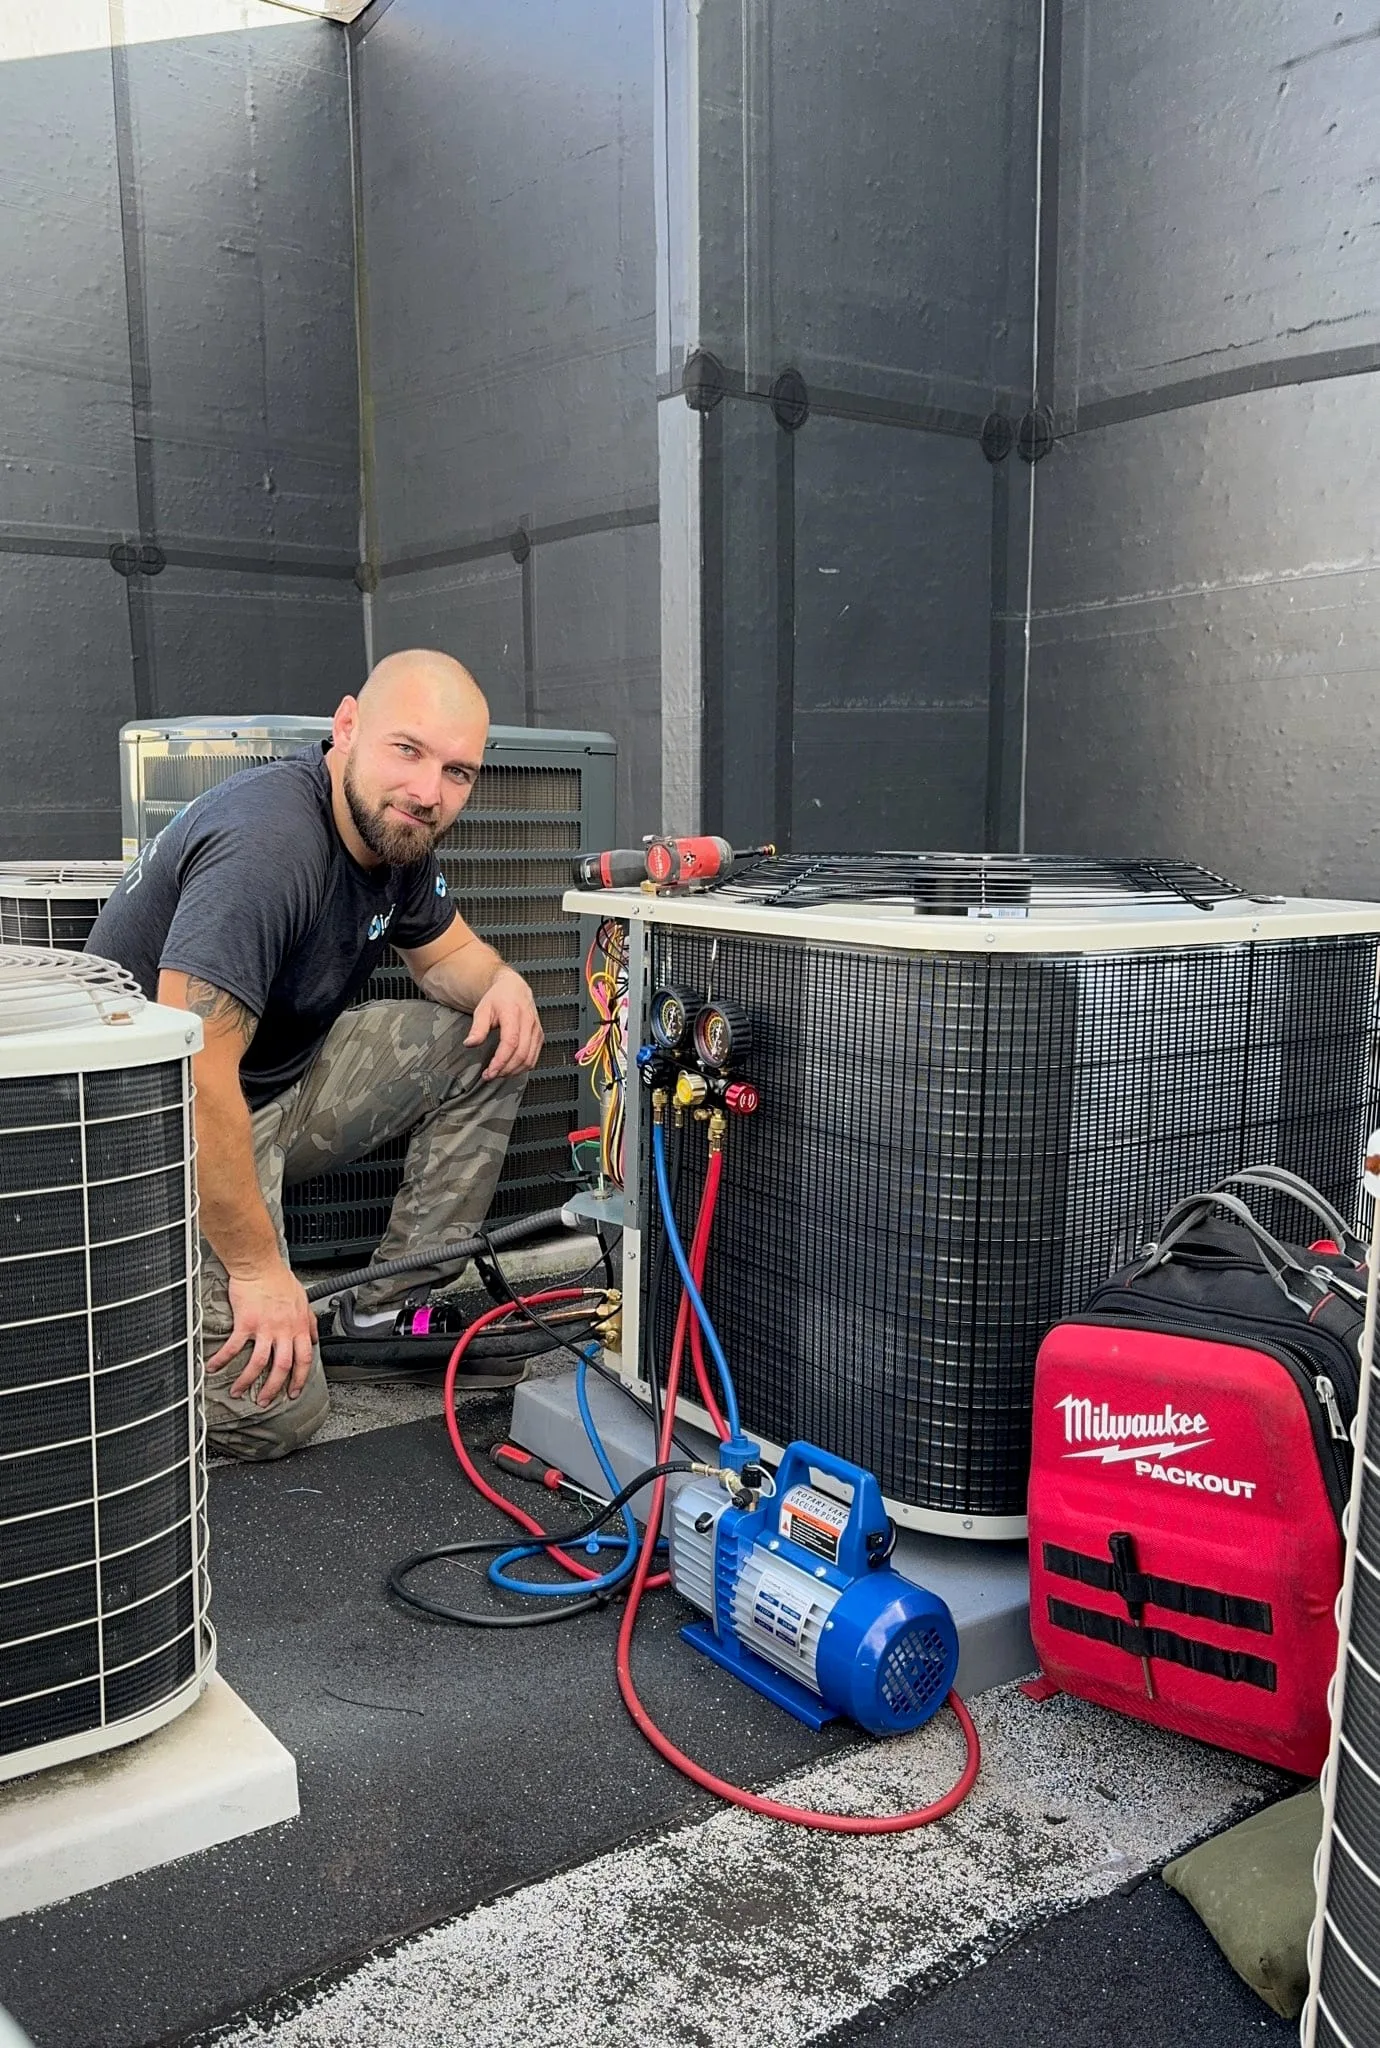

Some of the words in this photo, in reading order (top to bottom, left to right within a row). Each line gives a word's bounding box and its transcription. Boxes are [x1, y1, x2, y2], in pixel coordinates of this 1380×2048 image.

[1053, 1393, 1210, 1444] Milwaukee
[1135, 1460, 1256, 1499] PACKOUT
[791, 1495, 821, 1515] VACUUM
[820, 1511, 843, 1526] PUMP
[795, 1490, 826, 1508] ROTARY
[829, 1507, 848, 1520] VANE
